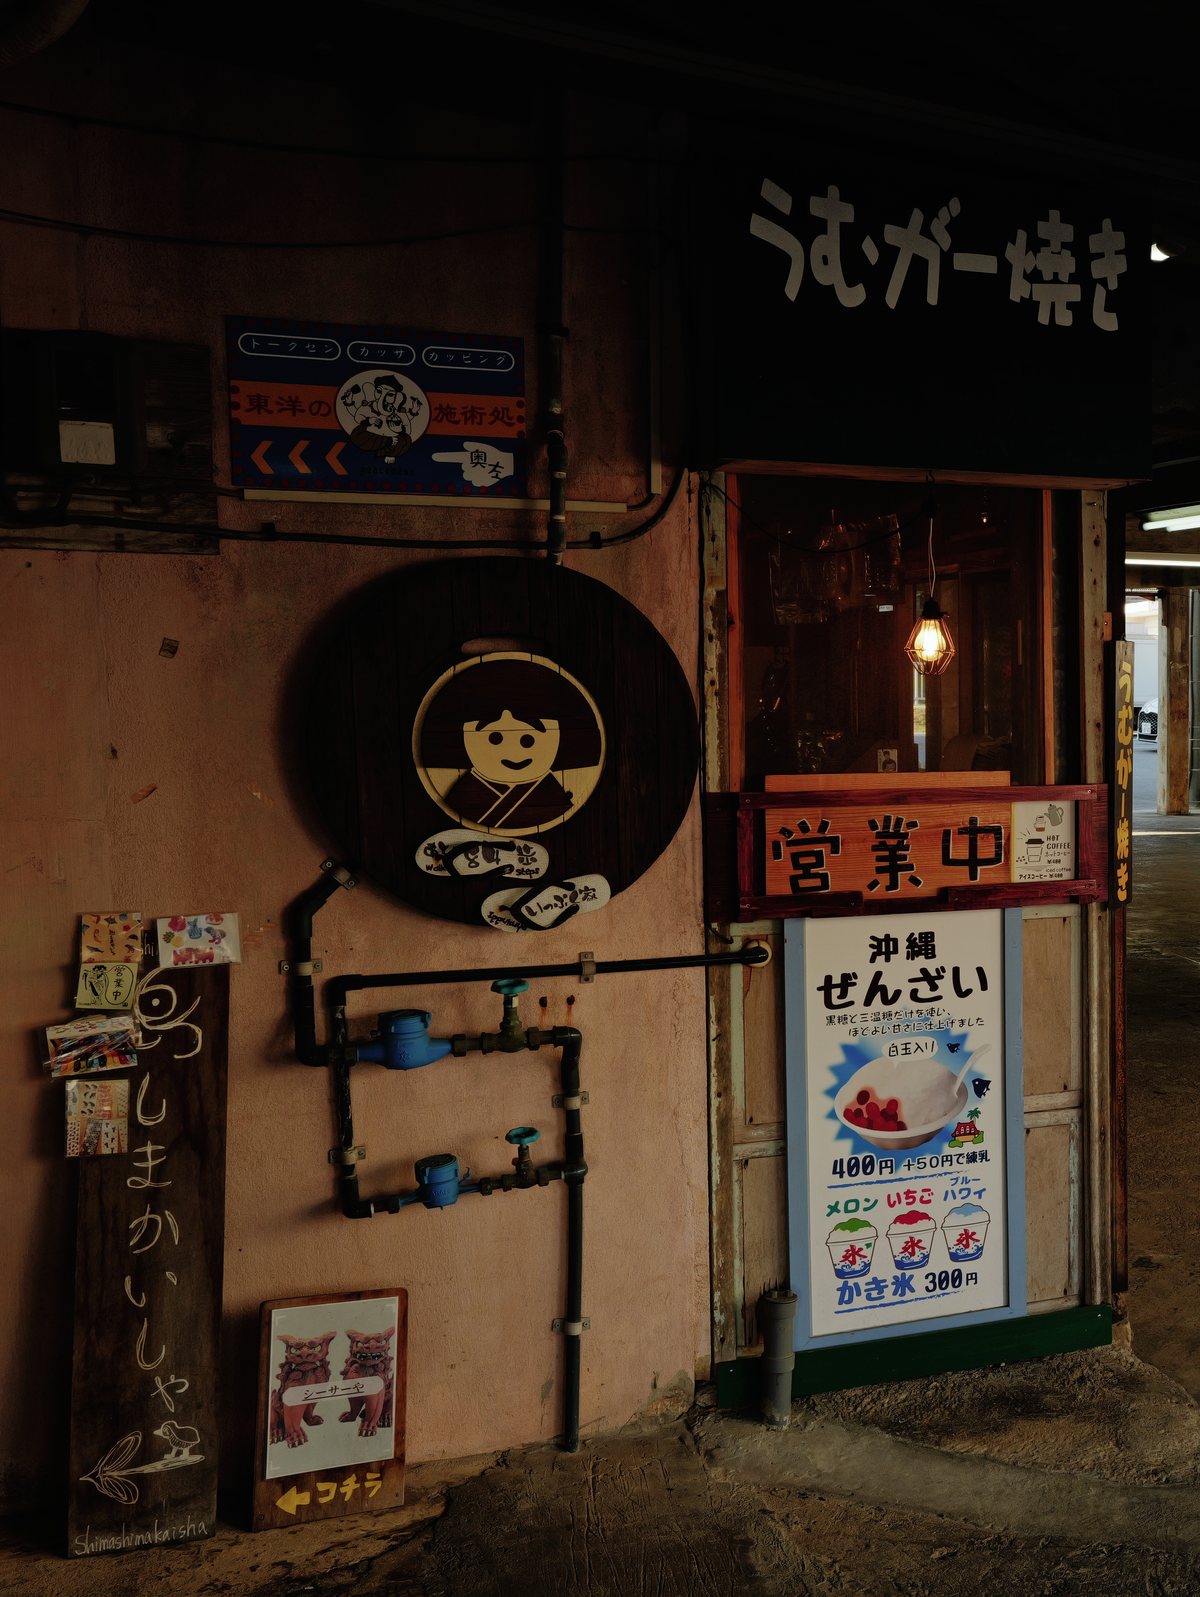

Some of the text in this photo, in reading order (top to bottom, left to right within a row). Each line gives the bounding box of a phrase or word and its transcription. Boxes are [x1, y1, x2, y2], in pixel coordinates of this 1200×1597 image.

[749, 176, 1128, 332] うむがー焼き
[250, 336, 334, 355] トークセン
[359, 345, 406, 361] カッサ
[428, 350, 508, 367] カッピング
[245, 393, 332, 419] 東洋の
[432, 402, 515, 428] 施術処
[1116, 660, 1133, 902] うむがー焼き
[772, 814, 1006, 895] 営業中
[1046, 842, 1072, 850] COFFEE
[515, 867, 540, 879] steps
[868, 931, 937, 964] 沖縄
[816, 965, 989, 1010] ぜんざい
[848, 1016, 986, 1038] ほどよい甘さに仕上げました
[888, 1040, 936, 1057] 白玉入り
[832, 1153, 894, 1179] 400円
[950, 1176, 981, 1188] ブルー
[886, 1188, 934, 1208] いちご
[943, 1187, 987, 1202] ハワイ
[826, 1197, 879, 1217] メロン
[899, 1236, 927, 1257] 氷
[954, 1229, 981, 1250] 氷
[839, 1244, 868, 1266] 氷
[836, 1268, 978, 1306] かき氷 300円
[304, 1381, 366, 1400] シーサーや
[316, 1472, 383, 1504] コチラ
[74, 1515, 208, 1556] Shimashimakaisha
